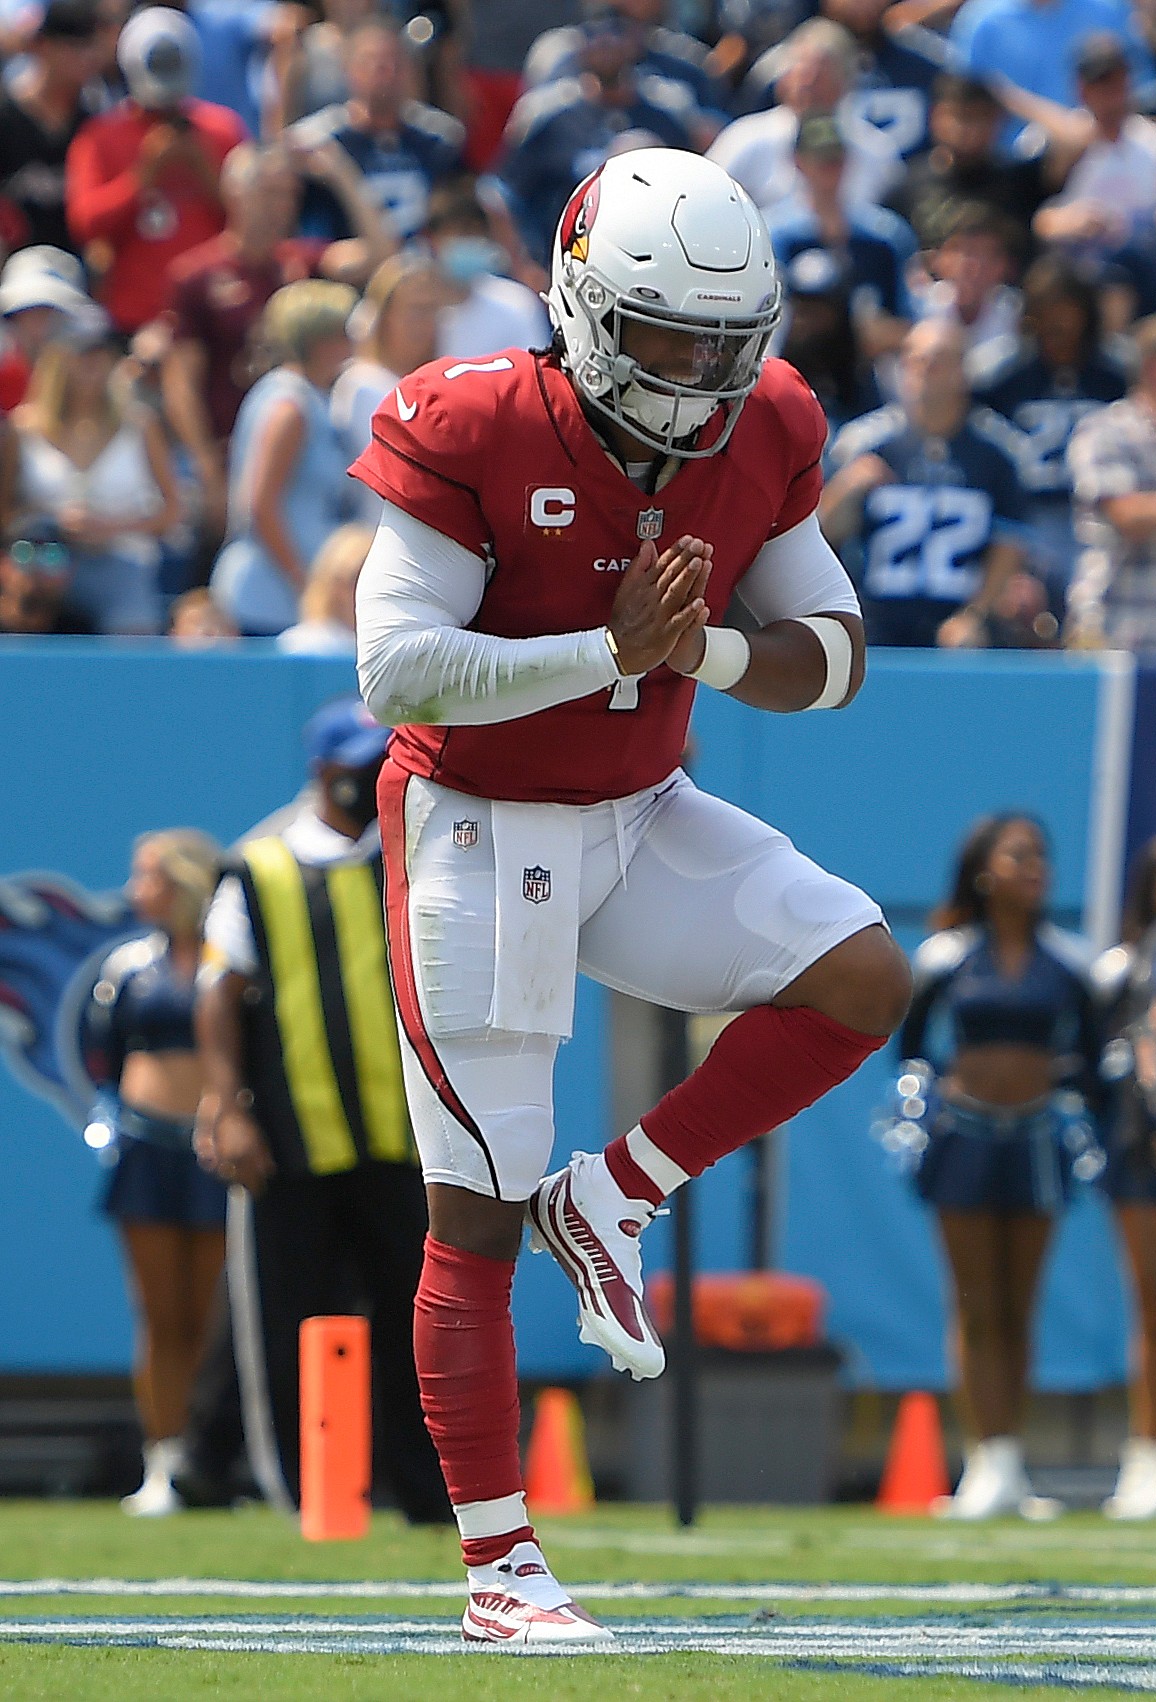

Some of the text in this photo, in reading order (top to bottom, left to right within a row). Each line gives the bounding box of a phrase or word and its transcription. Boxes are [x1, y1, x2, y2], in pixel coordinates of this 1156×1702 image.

[530, 487, 576, 527] C
[864, 484, 994, 598] 22
[456, 831, 475, 845] NFL
[526, 881, 549, 899] NFL
